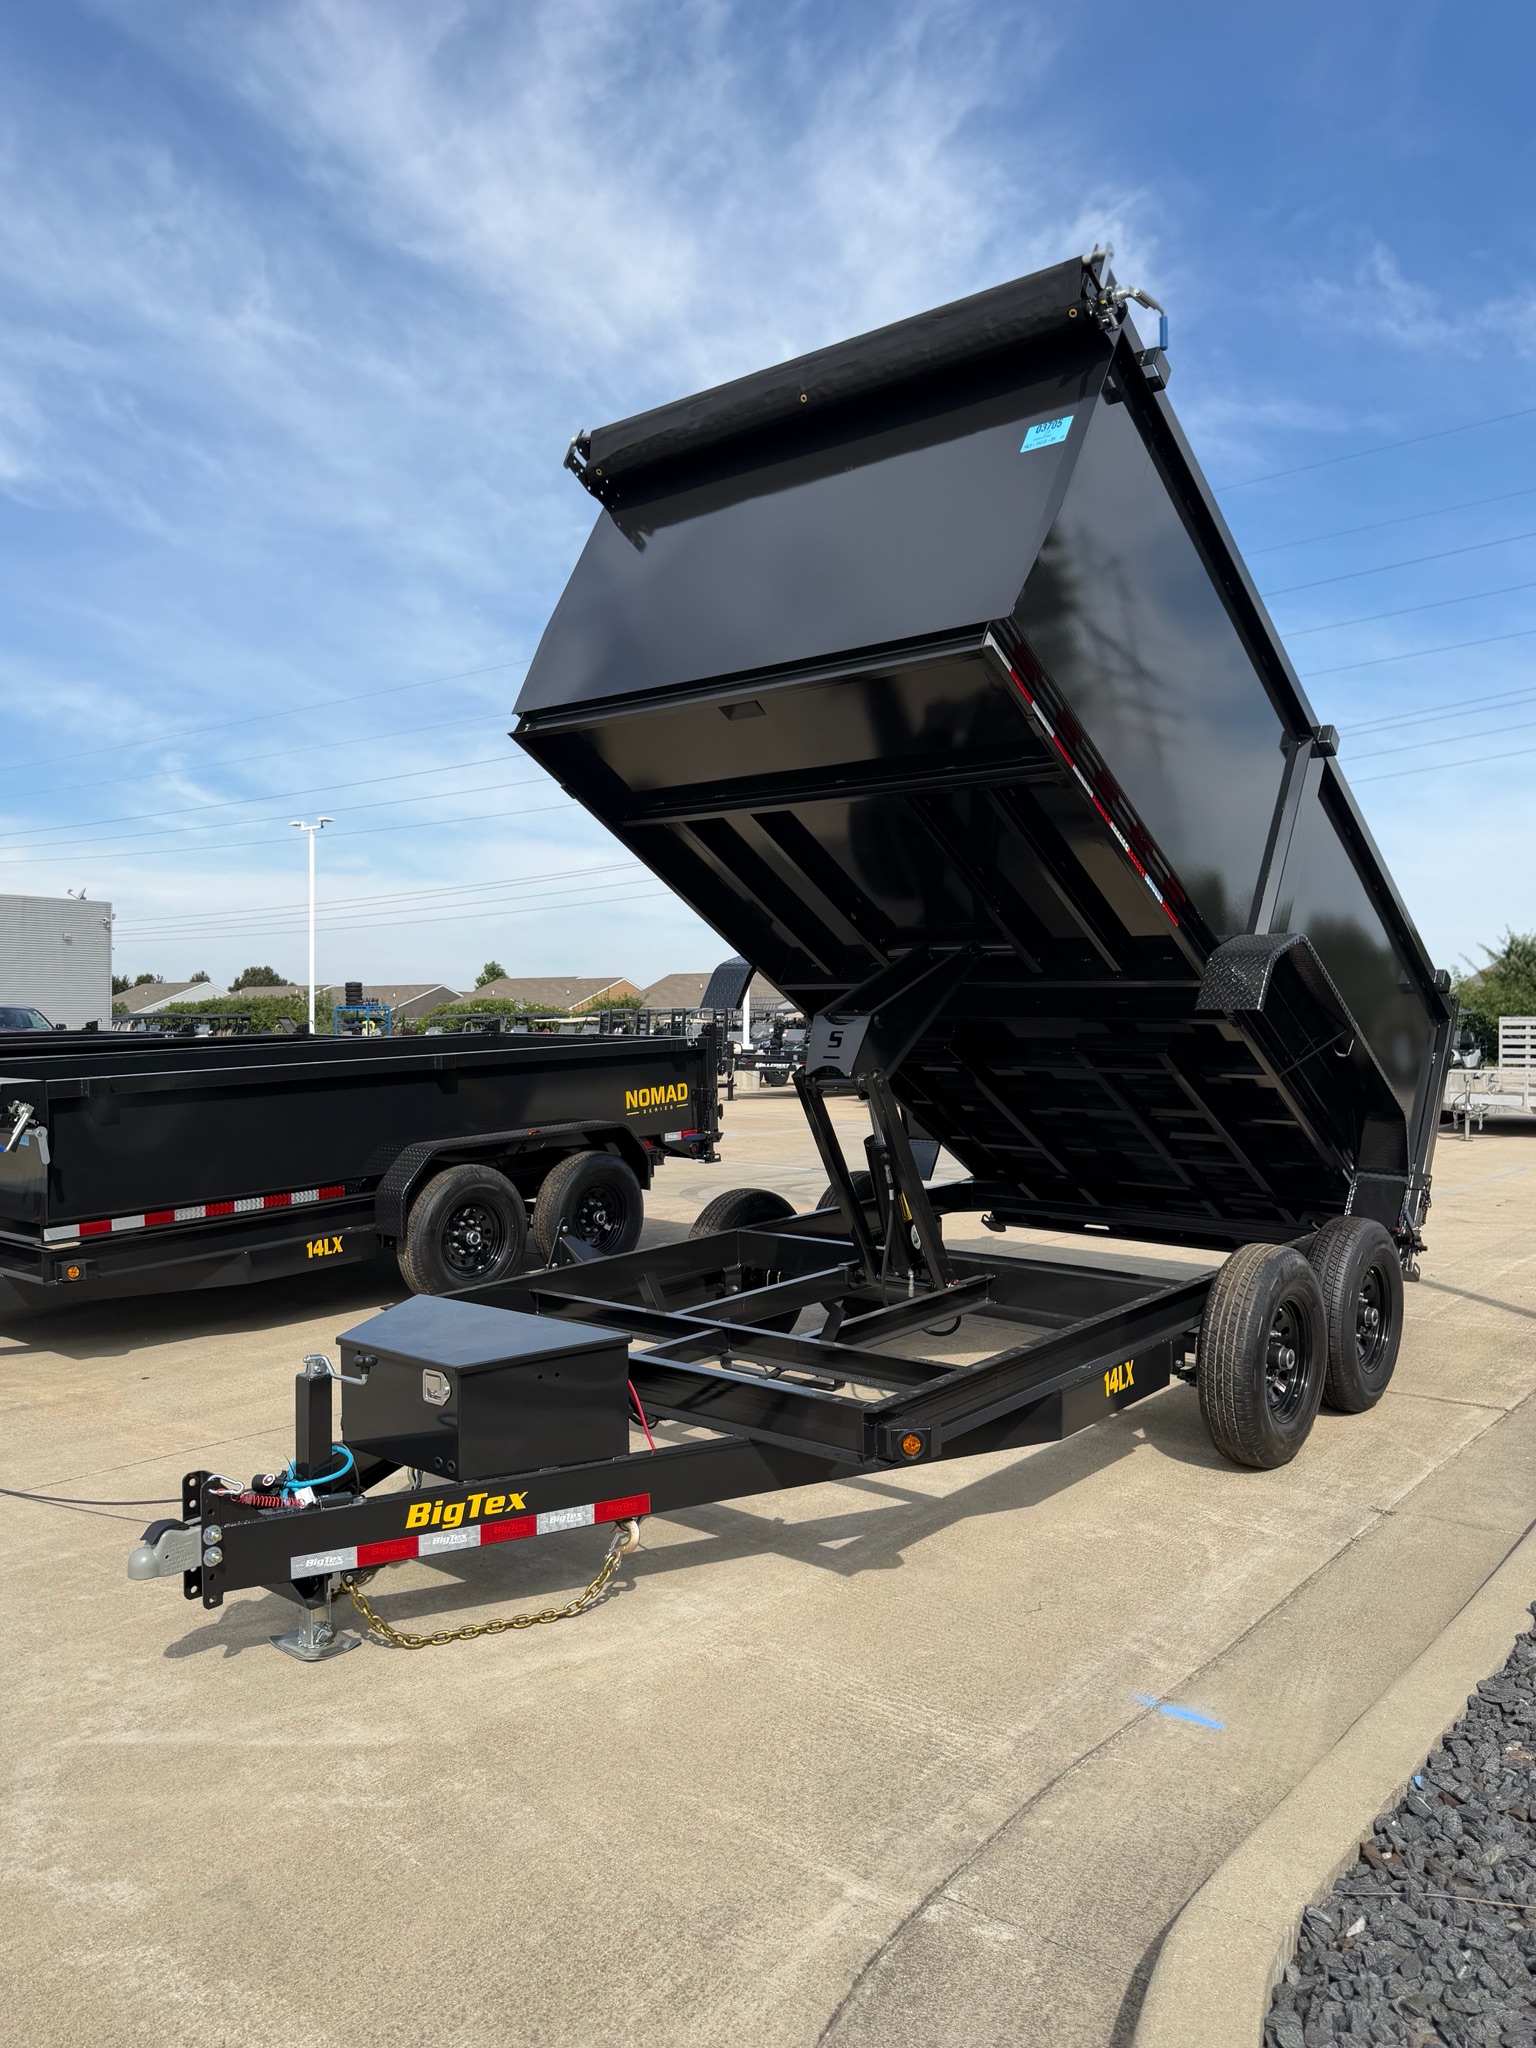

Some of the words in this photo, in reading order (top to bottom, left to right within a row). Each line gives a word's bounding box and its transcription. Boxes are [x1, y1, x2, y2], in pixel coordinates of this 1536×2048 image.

[625, 1082, 689, 1109] NOMAD
[643, 1105, 674, 1114] SERIES
[306, 1235, 344, 1259] 14LX
[1103, 1359, 1135, 1398] 14LX
[405, 1491, 529, 1529] BigTex
[549, 1511, 583, 1524] BigTex
[432, 1533, 468, 1545] BigTex
[305, 1555, 343, 1567] BigTex
